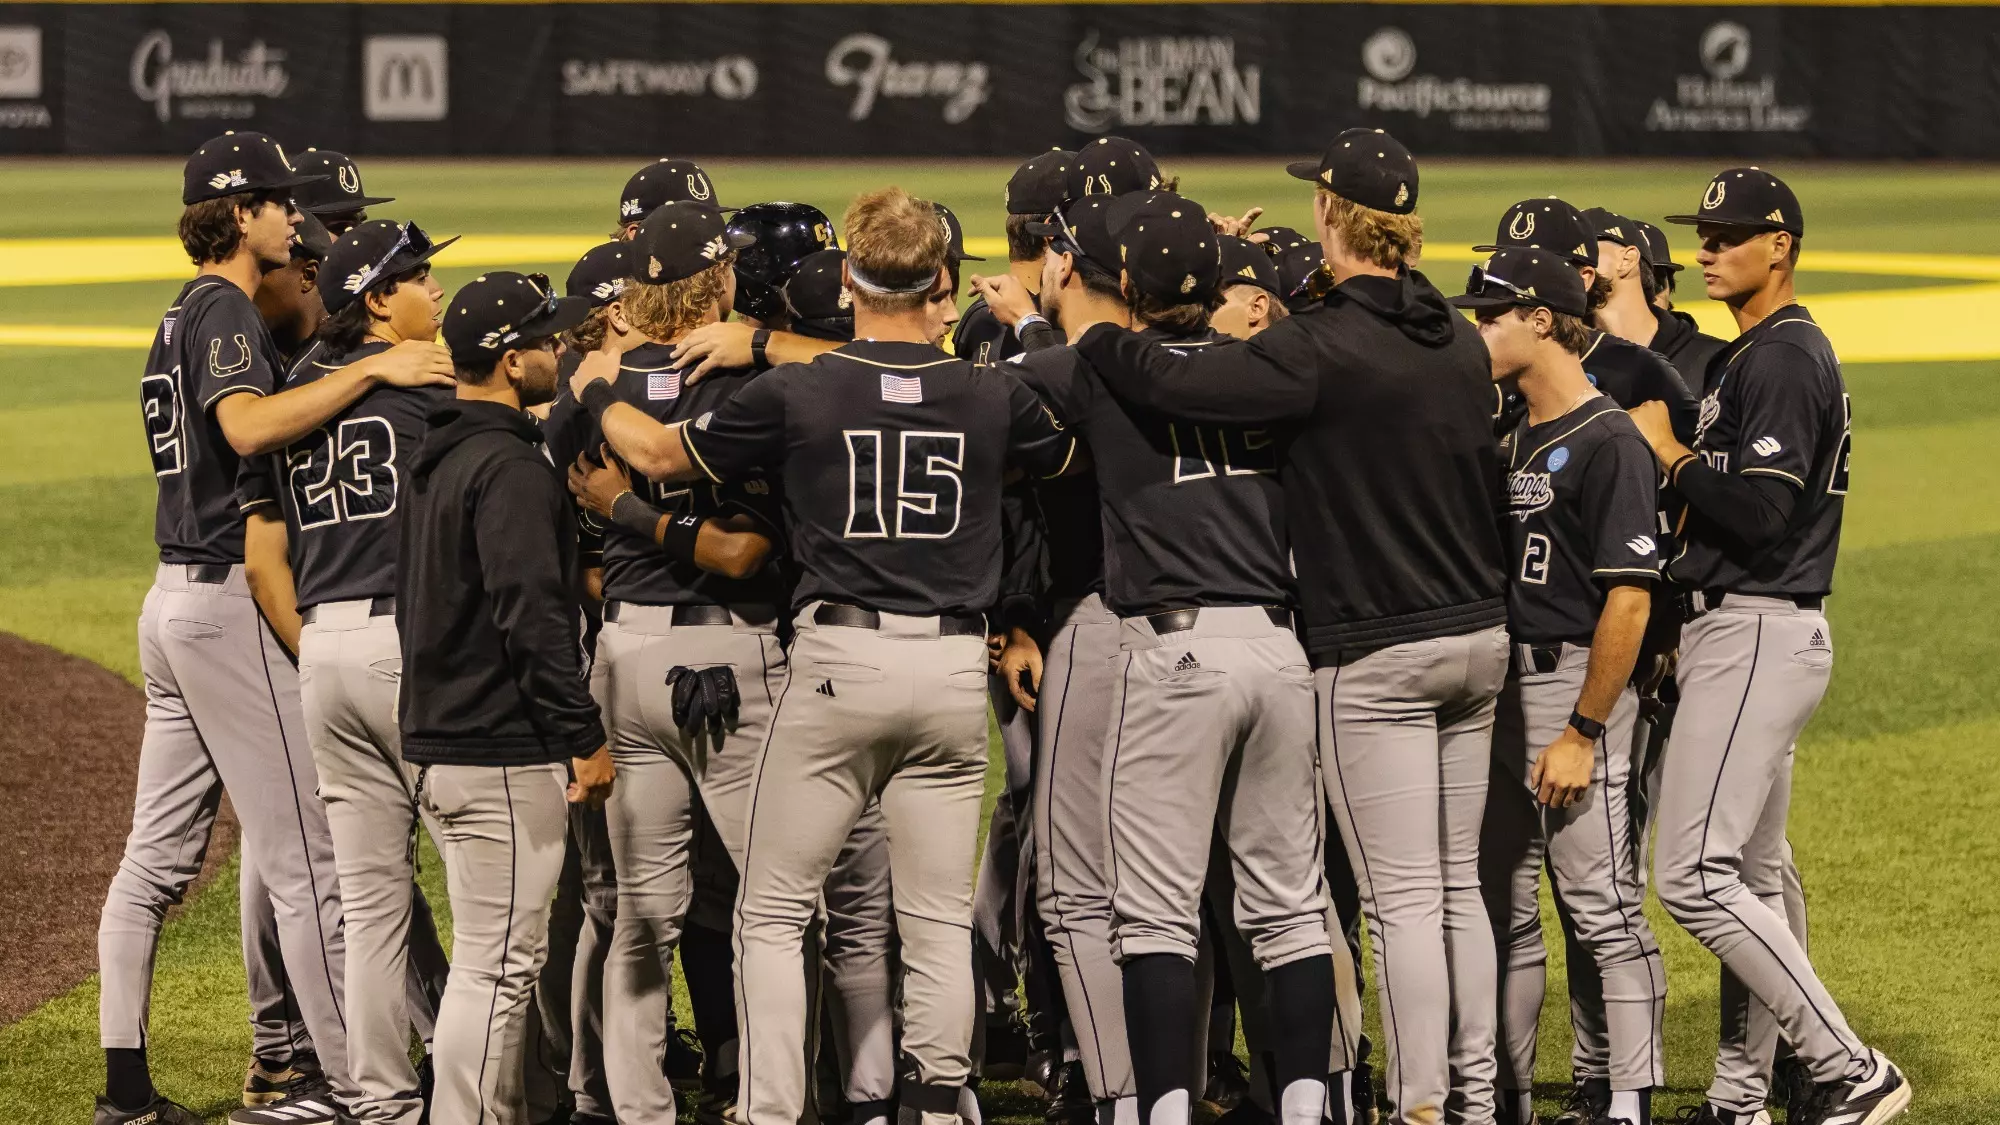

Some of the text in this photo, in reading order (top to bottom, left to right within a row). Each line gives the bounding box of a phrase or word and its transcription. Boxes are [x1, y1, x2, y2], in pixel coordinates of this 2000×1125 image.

[130, 30, 288, 122] Graduate
[562, 58, 711, 96] SAFEWAY
[1119, 37, 1234, 70] HUMAN
[1119, 66, 1260, 125] BEAN
[287, 416, 399, 531] 23
[842, 429, 965, 539] 15
[1520, 532, 1551, 585] 2
[1174, 661, 1201, 671] adidas
